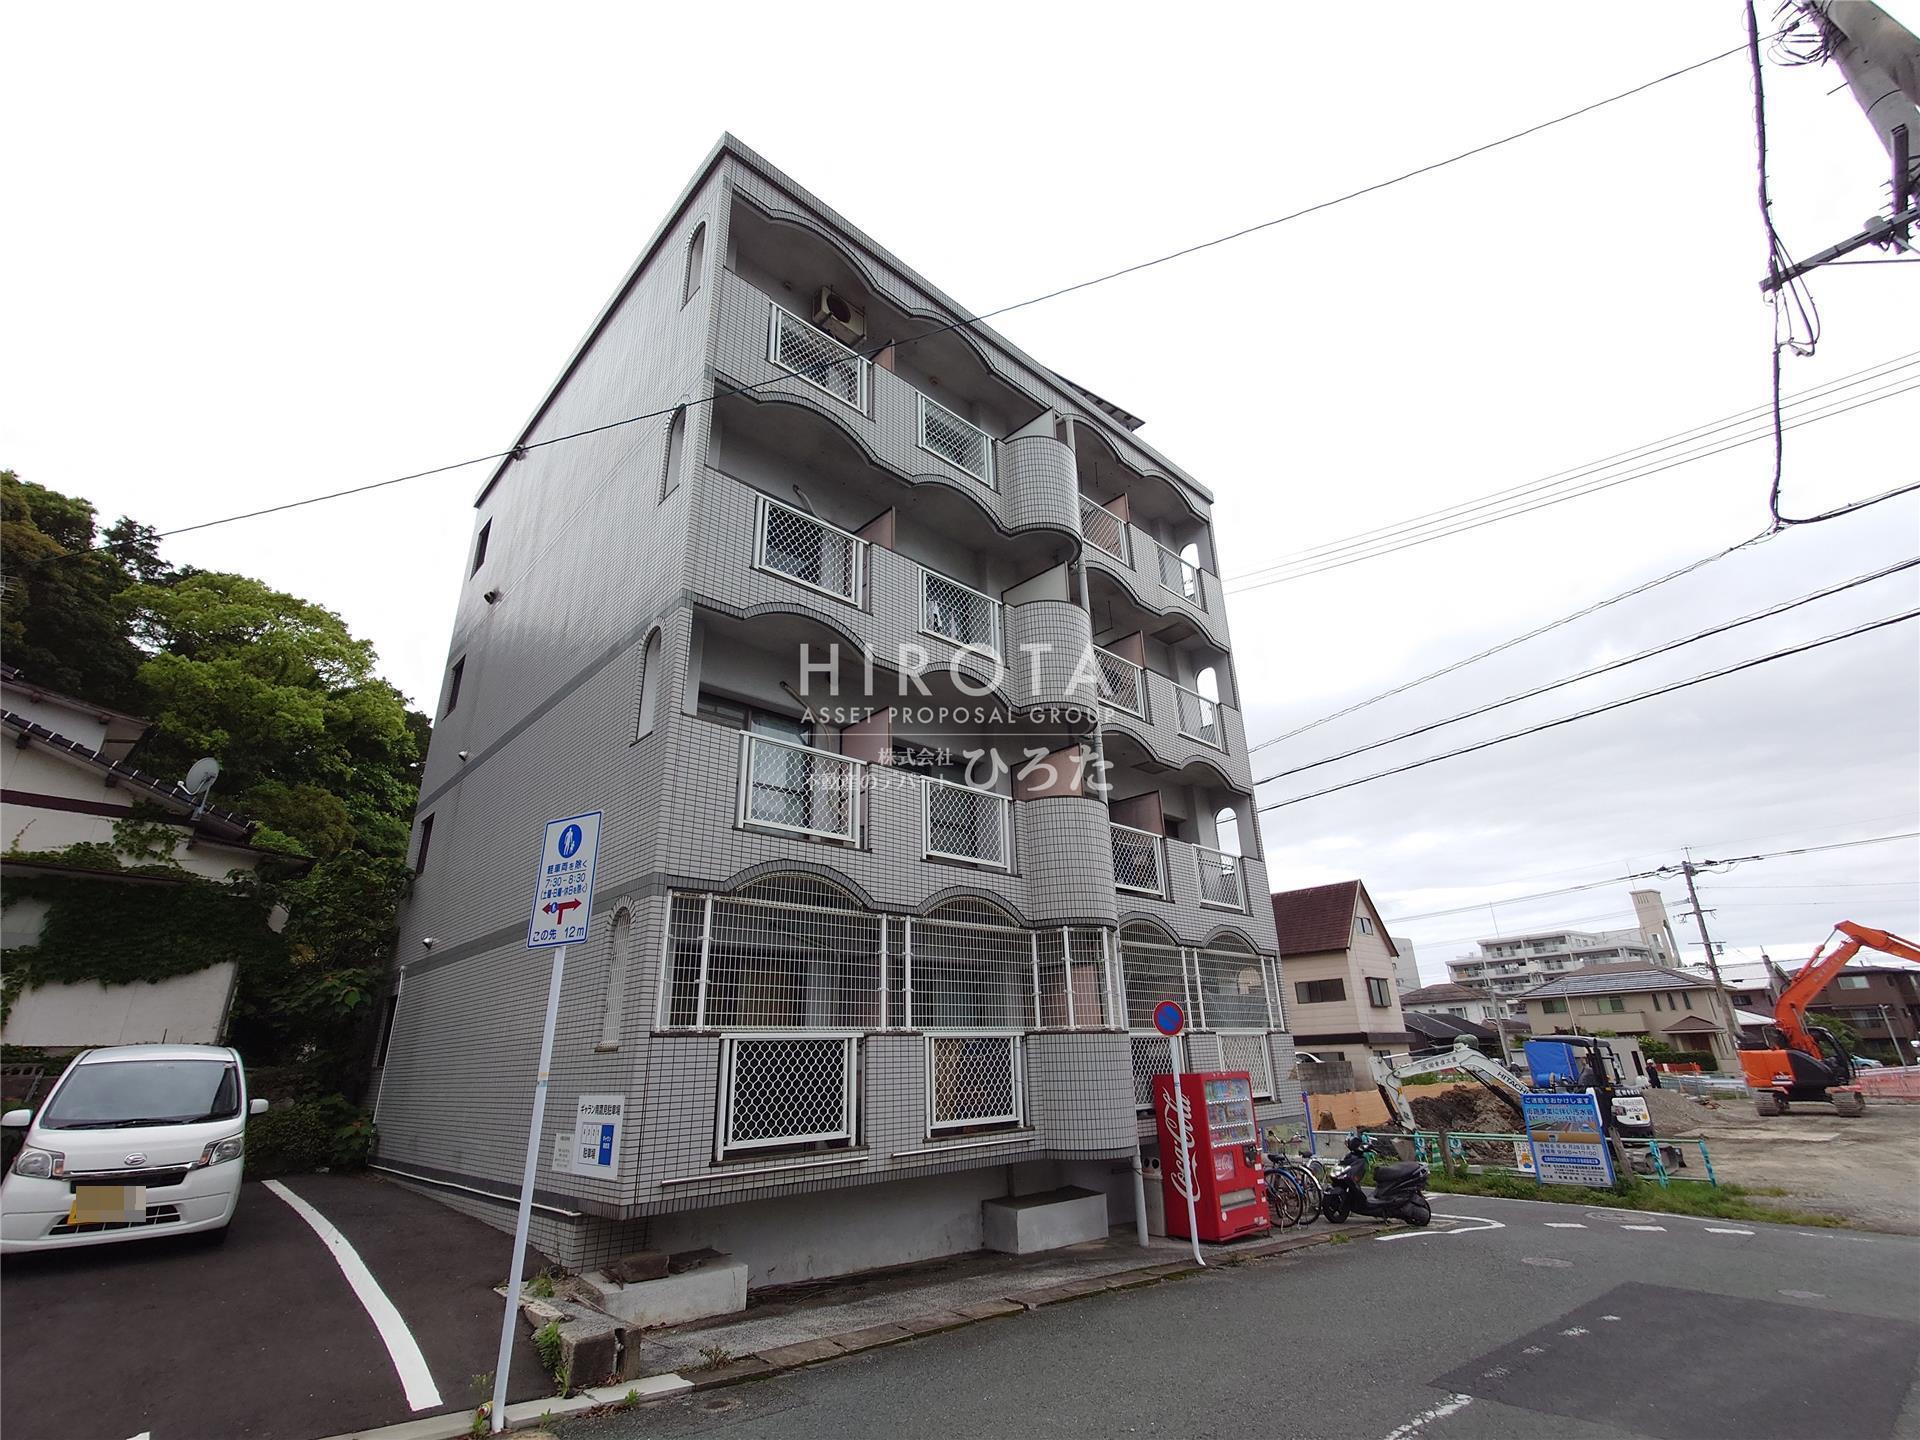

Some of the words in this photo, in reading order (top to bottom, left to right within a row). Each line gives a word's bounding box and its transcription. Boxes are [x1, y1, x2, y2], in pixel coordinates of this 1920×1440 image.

[547, 860, 587, 874] 軽車両を除く
[533, 929, 557, 942] この先
[565, 926, 584, 939] 12m
